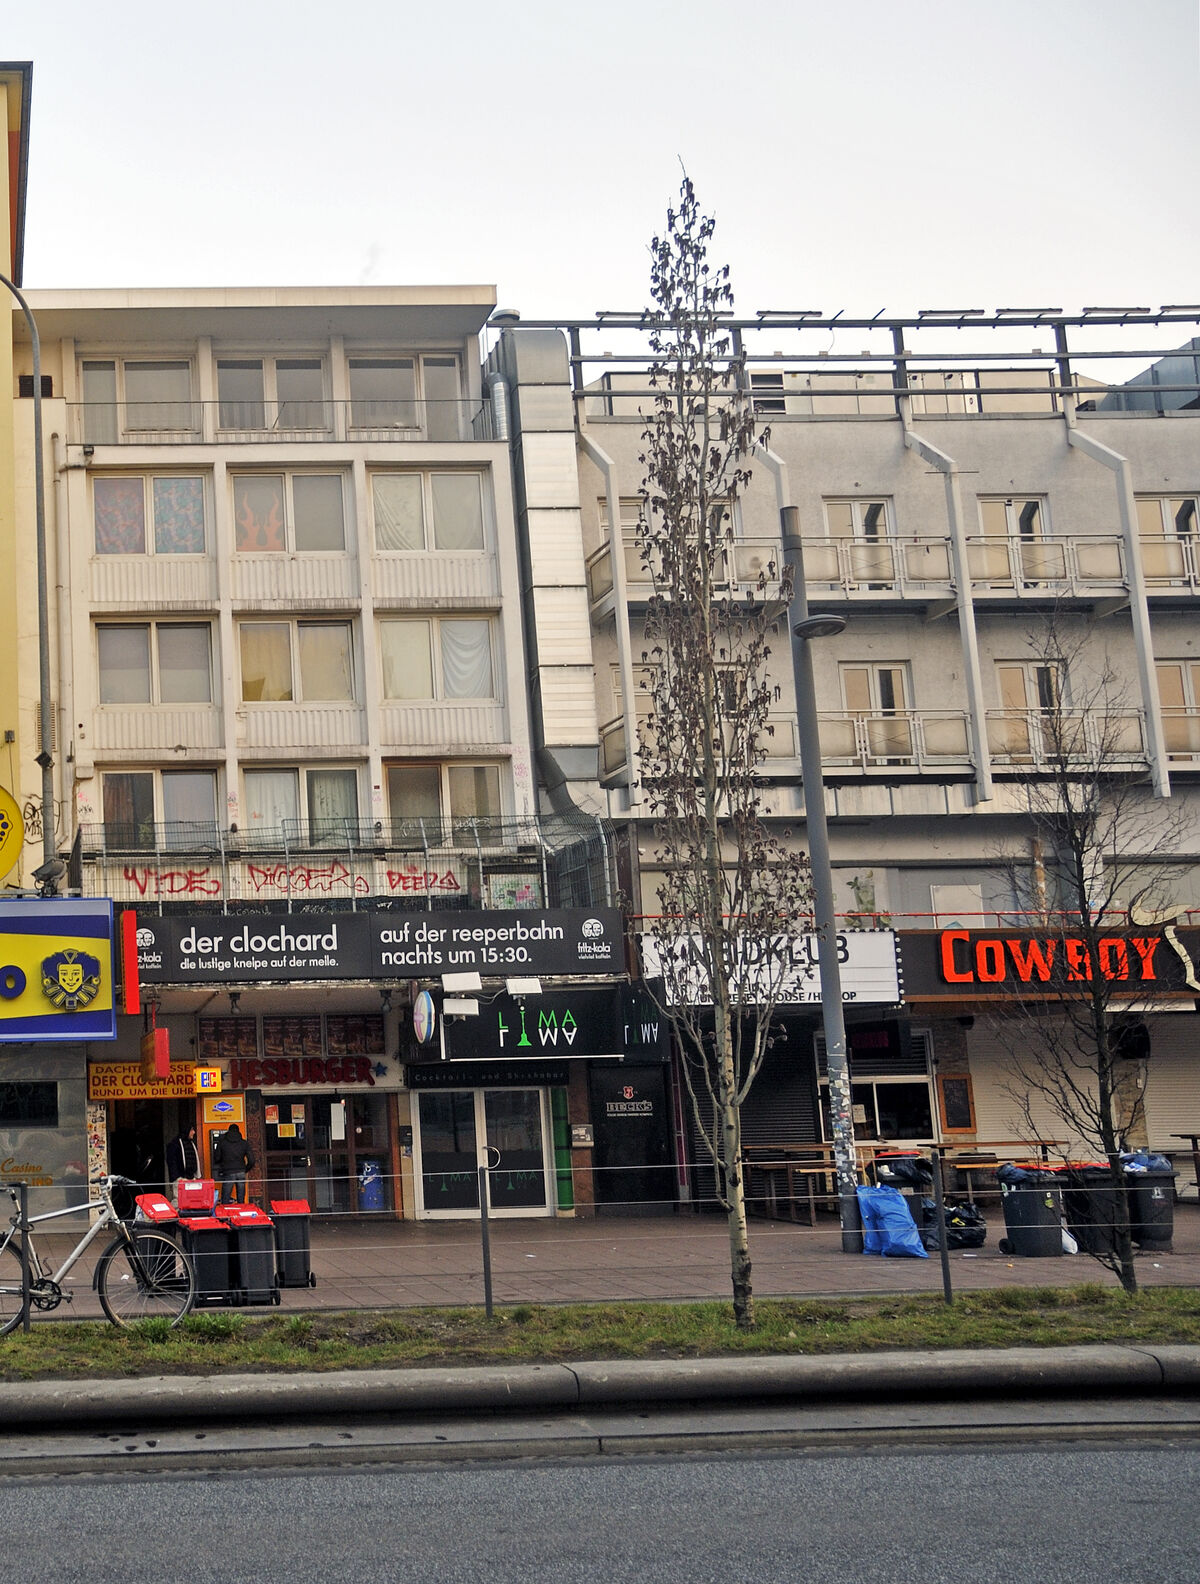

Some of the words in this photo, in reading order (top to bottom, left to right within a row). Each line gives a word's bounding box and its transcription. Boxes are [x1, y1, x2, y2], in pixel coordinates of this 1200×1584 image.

[180, 926, 223, 954] der
[229, 923, 338, 953] clochard
[380, 922, 410, 944] auf
[414, 921, 447, 943] der
[452, 920, 564, 945] reeperbahn
[381, 944, 443, 965] nachts
[448, 950, 476, 964] um
[480, 946, 532, 963] 15:30.
[577, 942, 610, 953] fritz-kola
[180, 957, 196, 970] die
[198, 957, 231, 971] lustige
[233, 956, 268, 971] kneipe
[270, 956, 287, 967] auf
[289, 955, 306, 967] der
[309, 954, 339, 967] meile.
[229, 1056, 376, 1088] HESBURGER
[92, 1075, 118, 1087] DER
[92, 1088, 124, 1097] RUND
[129, 1088, 147, 1096] UM
[151, 1087, 168, 1096] DIE
[171, 1087, 194, 1096] UHR
[0, 1157, 43, 1174] Casino
